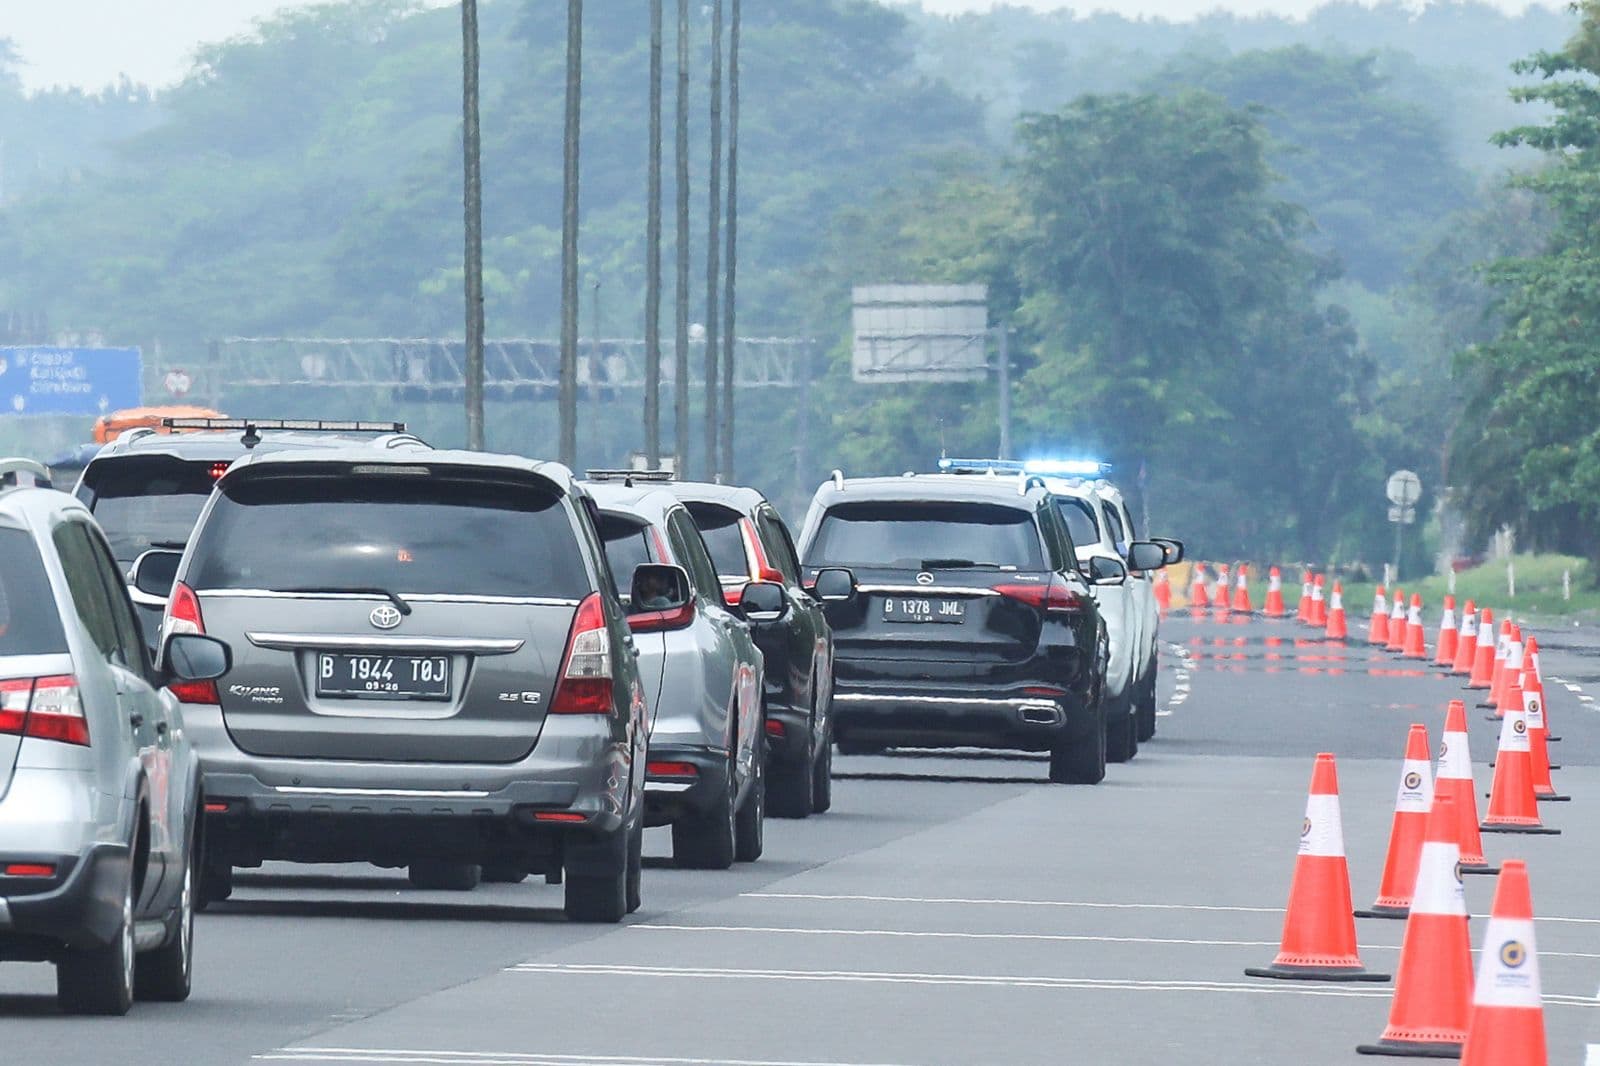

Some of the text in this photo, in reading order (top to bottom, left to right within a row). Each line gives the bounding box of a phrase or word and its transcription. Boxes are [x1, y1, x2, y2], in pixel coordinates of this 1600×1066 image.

[885, 599, 893, 612] B
[902, 600, 930, 614] 1378
[321, 656, 333, 678] B
[350, 658, 394, 681] 1944
